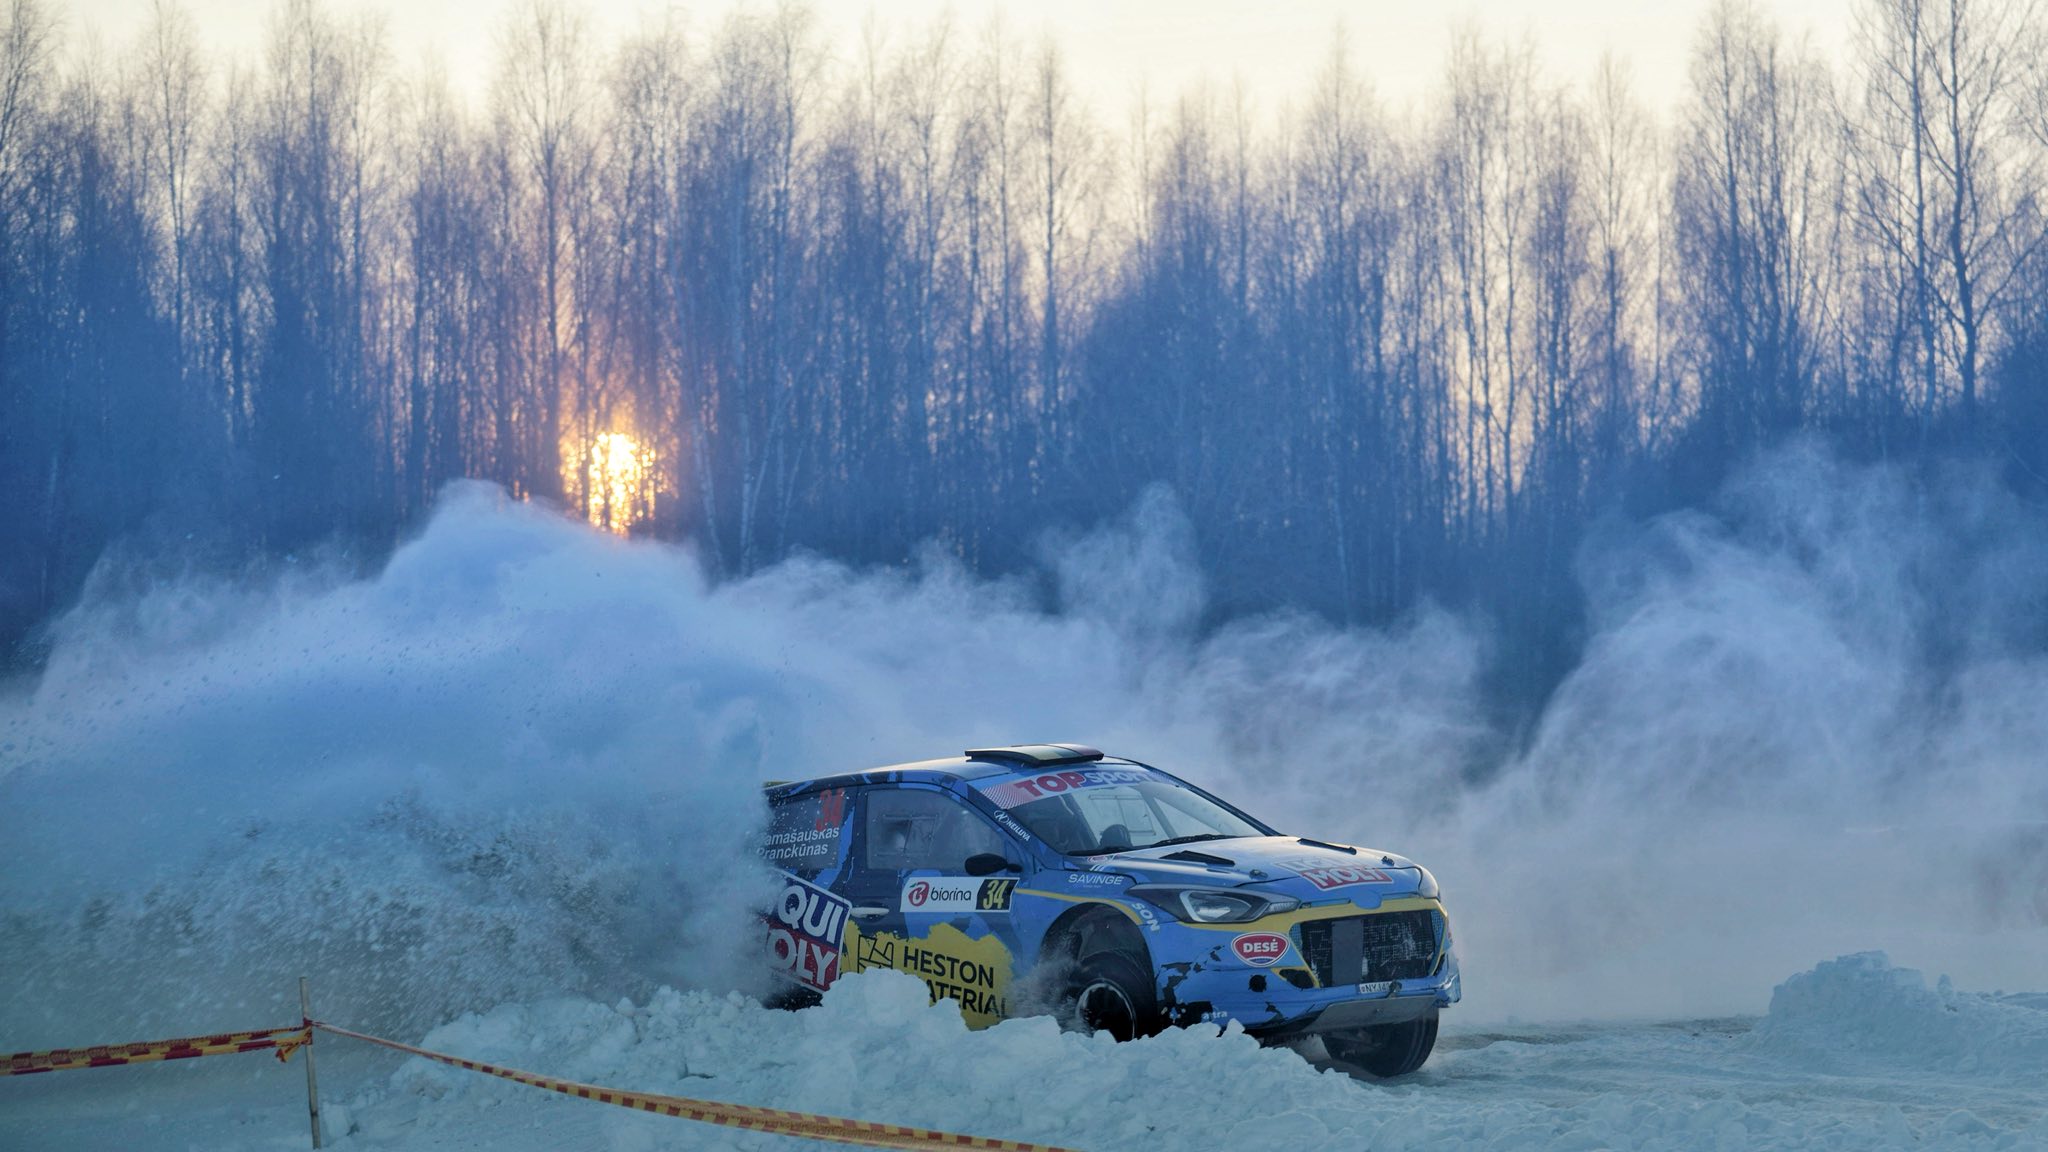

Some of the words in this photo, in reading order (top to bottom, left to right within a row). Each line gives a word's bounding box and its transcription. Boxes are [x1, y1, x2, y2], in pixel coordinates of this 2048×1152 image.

[765, 826, 840, 846] amašauskas
[930, 887, 972, 902] biorina
[982, 879, 1010, 910] 34
[1068, 873, 1125, 886] SAVINGE
[778, 884, 844, 945] QUI
[766, 928, 837, 987] OLY
[903, 945, 994, 989] HESTON
[926, 978, 1007, 1018] ATERIAL
